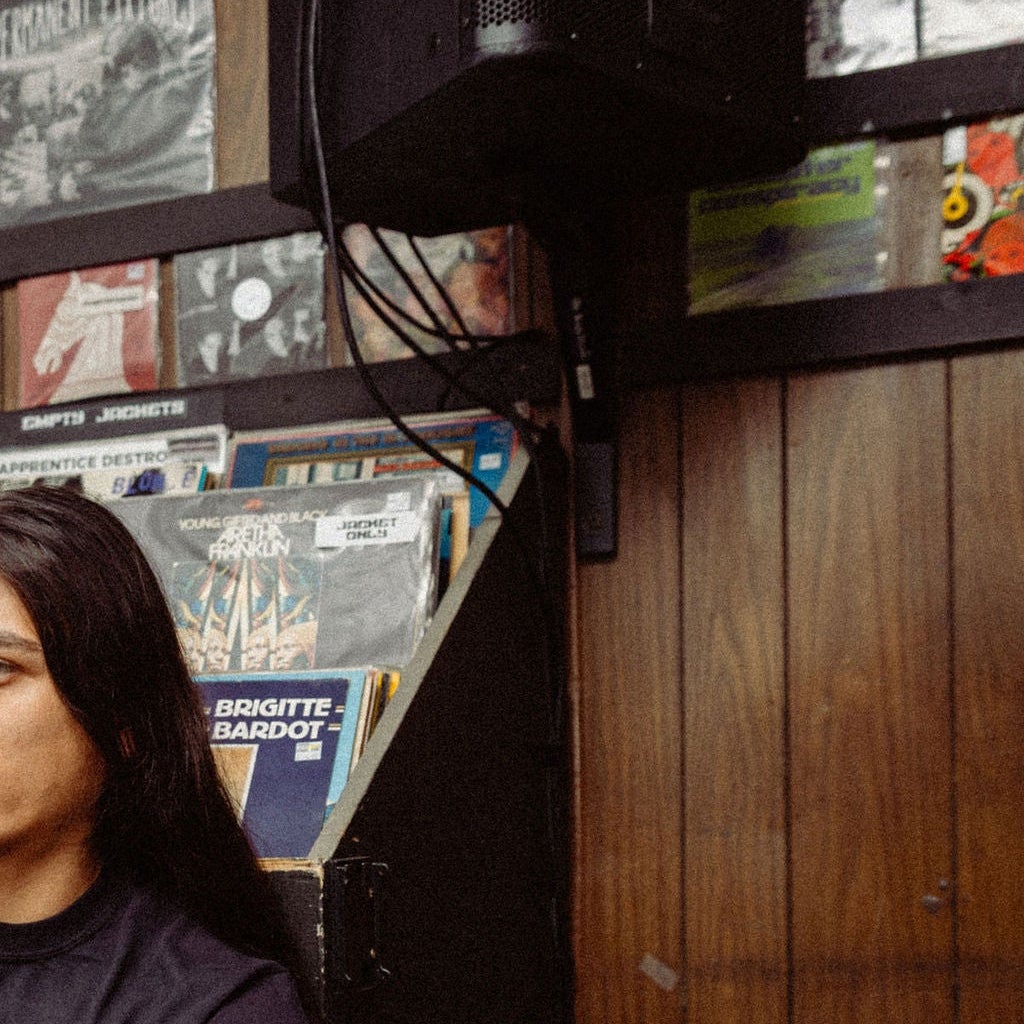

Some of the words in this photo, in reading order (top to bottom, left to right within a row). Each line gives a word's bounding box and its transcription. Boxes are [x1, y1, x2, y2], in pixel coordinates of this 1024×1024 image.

[21, 410, 85, 430] EMPTY
[95, 399, 185, 423] JACKETS
[0, 454, 96, 475] APPRENTICE
[102, 451, 168, 468] DESTRO
[337, 517, 396, 530] JACKET
[346, 529, 387, 540] ONLY
[209, 538, 290, 560] FRANKLIN
[214, 698, 332, 717] BRIGITTE
[212, 720, 324, 740] BARDOT
